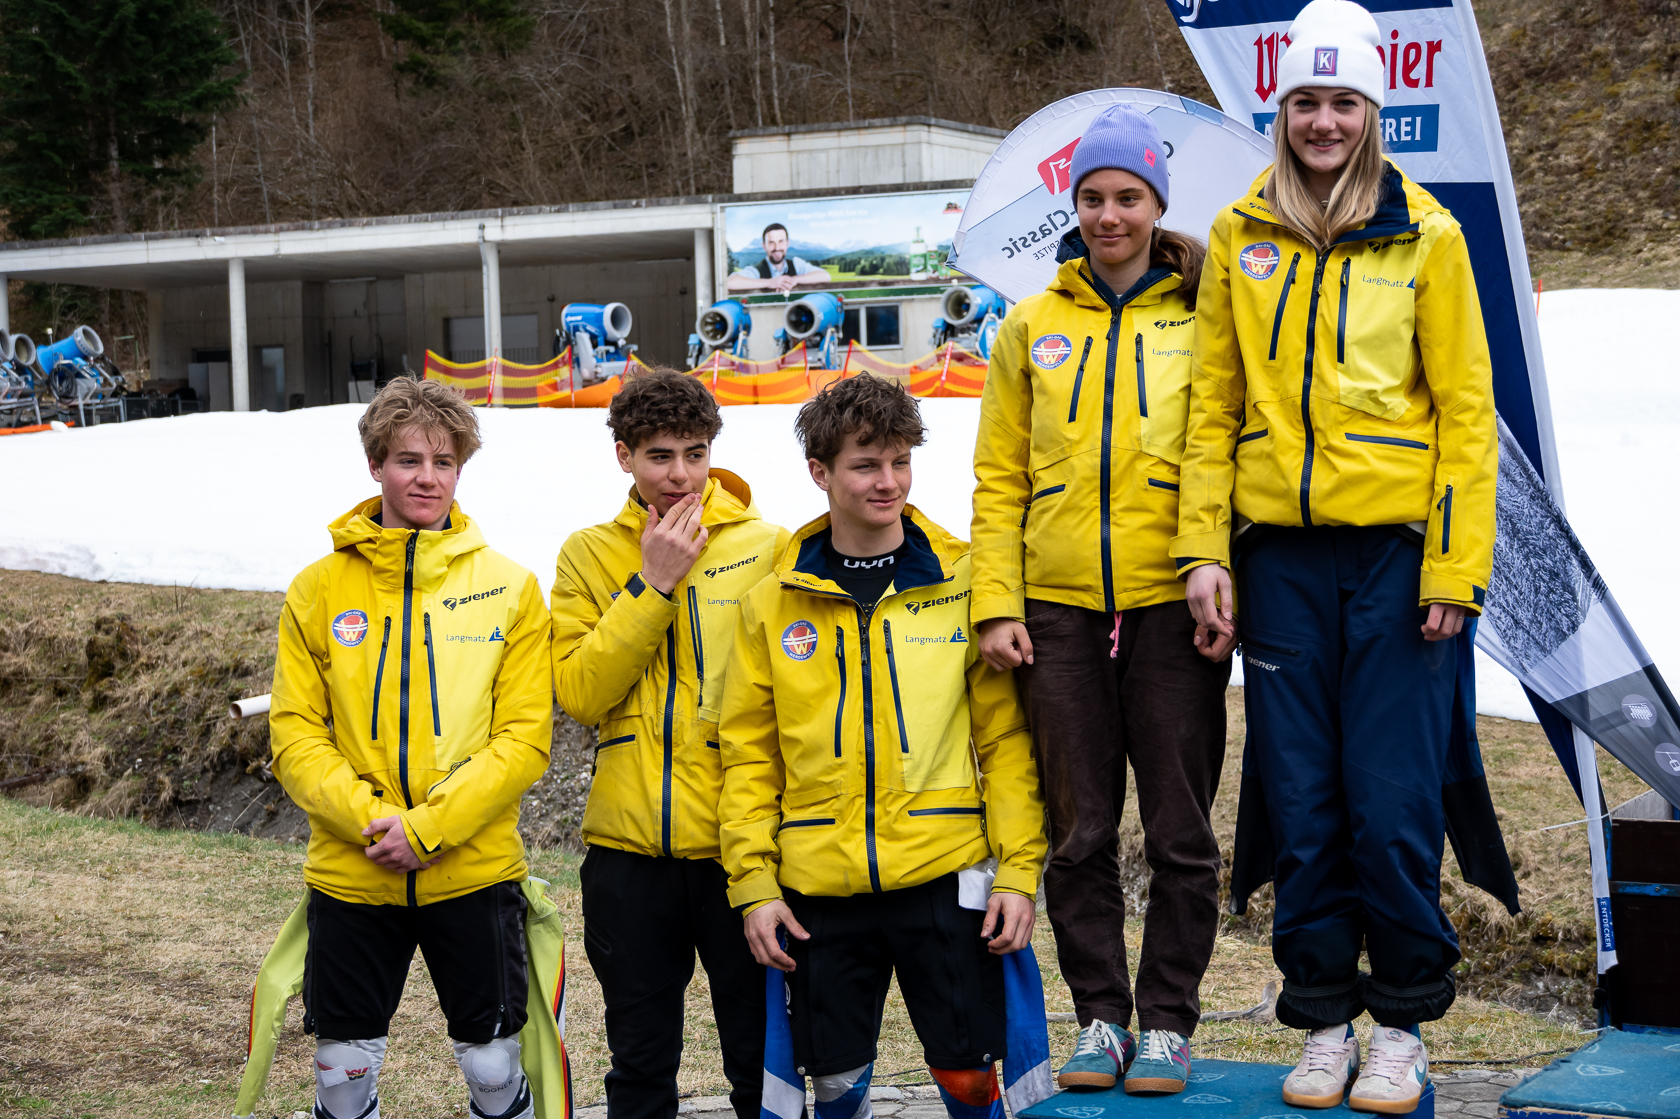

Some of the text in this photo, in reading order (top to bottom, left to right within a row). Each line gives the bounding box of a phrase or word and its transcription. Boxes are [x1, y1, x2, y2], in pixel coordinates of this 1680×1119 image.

[1318, 52, 1331, 70] K
[1168, 315, 1196, 327] zien
[717, 555, 759, 574] ziener
[458, 585, 507, 605] ziener
[707, 598, 740, 607] Langmat
[921, 589, 972, 609] ziener
[445, 633, 487, 644] Langmatz
[905, 634, 947, 646] Langmatz
[478, 1078, 514, 1094] BOGNER
